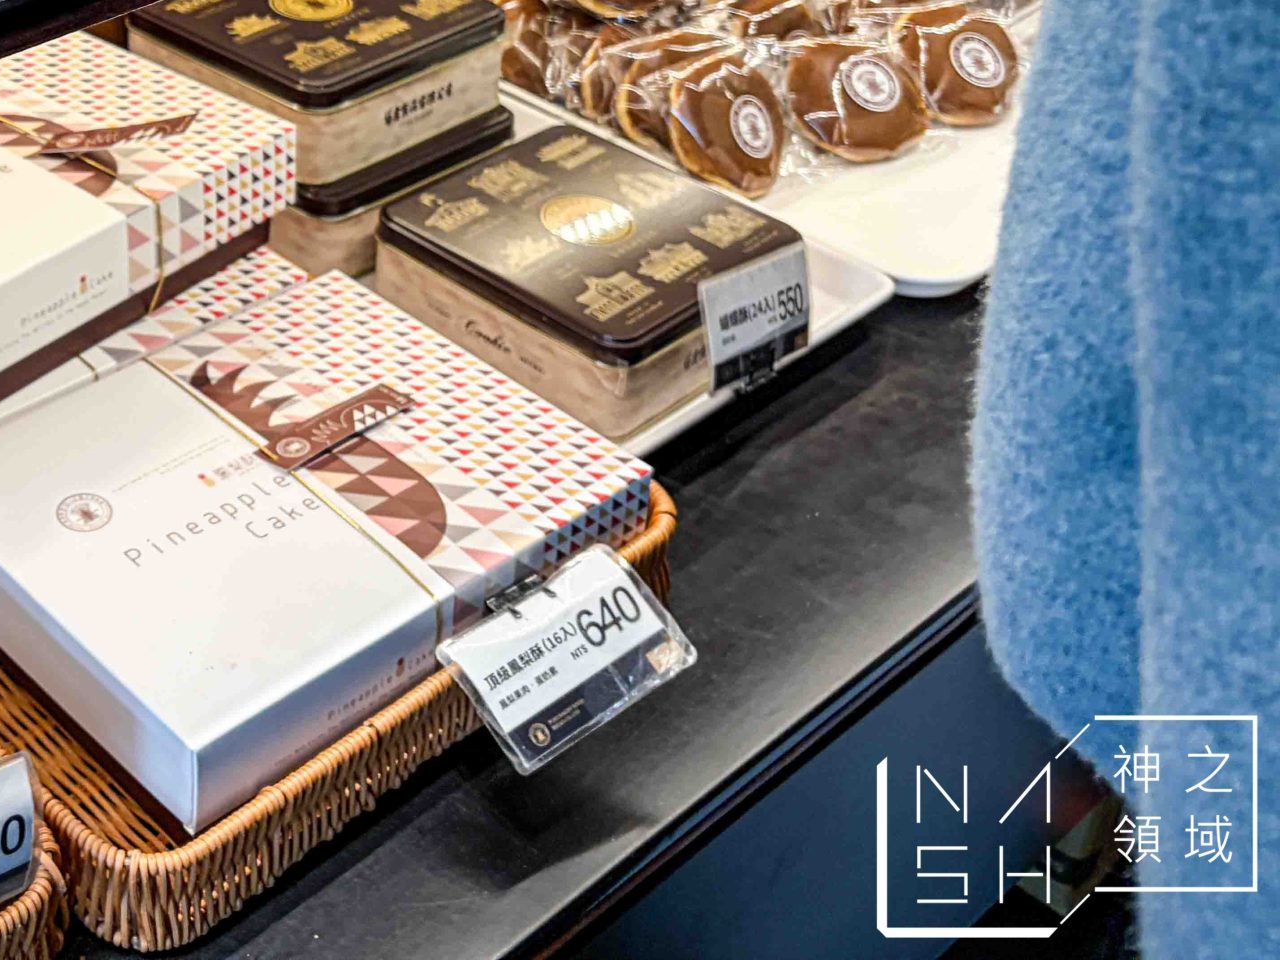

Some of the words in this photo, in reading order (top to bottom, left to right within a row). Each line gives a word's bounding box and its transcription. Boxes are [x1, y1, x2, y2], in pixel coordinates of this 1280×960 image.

[777, 283, 804, 320] 550
[123, 474, 290, 567] Pineapple
[244, 497, 320, 539] Cake
[576, 586, 640, 647] 640
[570, 644, 589, 661] NT$
